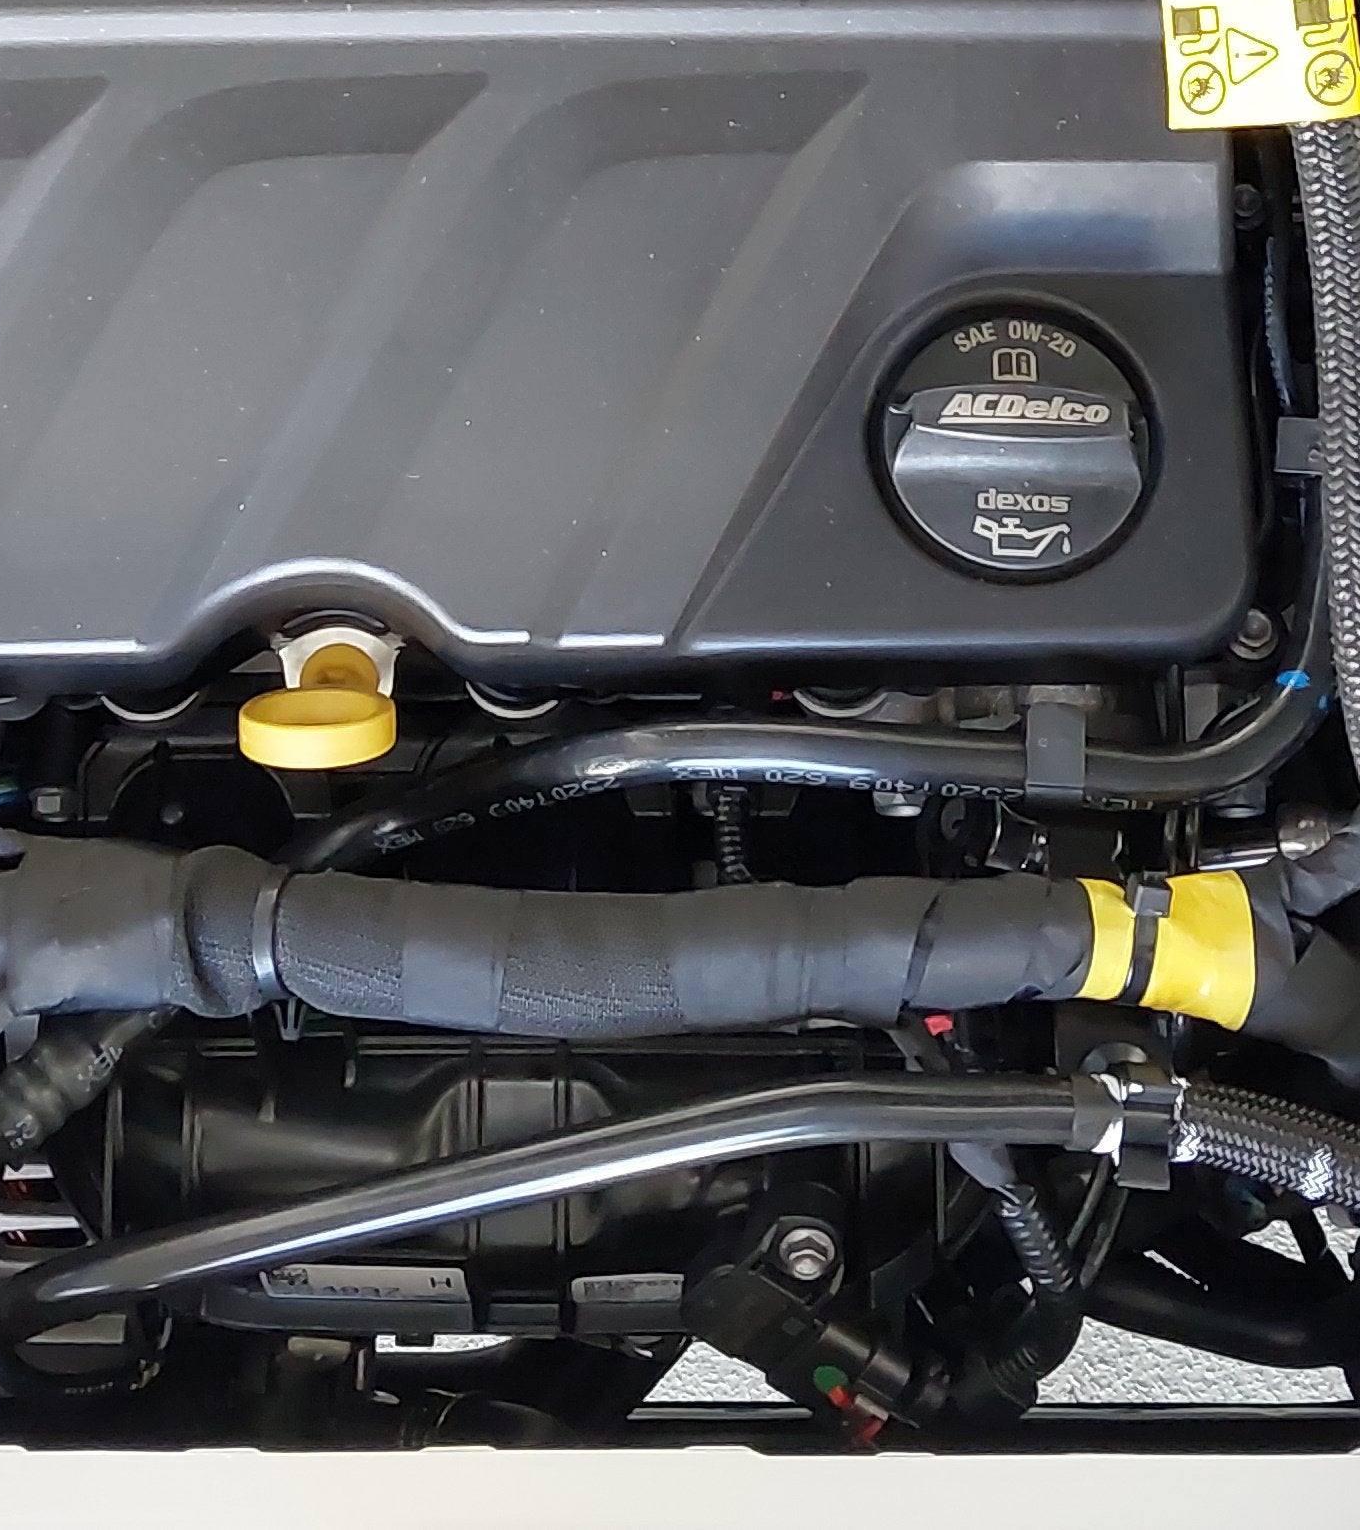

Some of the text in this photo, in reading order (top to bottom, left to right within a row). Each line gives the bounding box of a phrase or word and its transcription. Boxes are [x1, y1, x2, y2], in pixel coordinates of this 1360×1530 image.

[953, 320, 1078, 359] SAE 0W-20
[938, 392, 1111, 425] ACDelco
[976, 487, 1072, 514] dexos
[670, 765, 739, 783] MEX
[764, 766, 828, 787] 620
